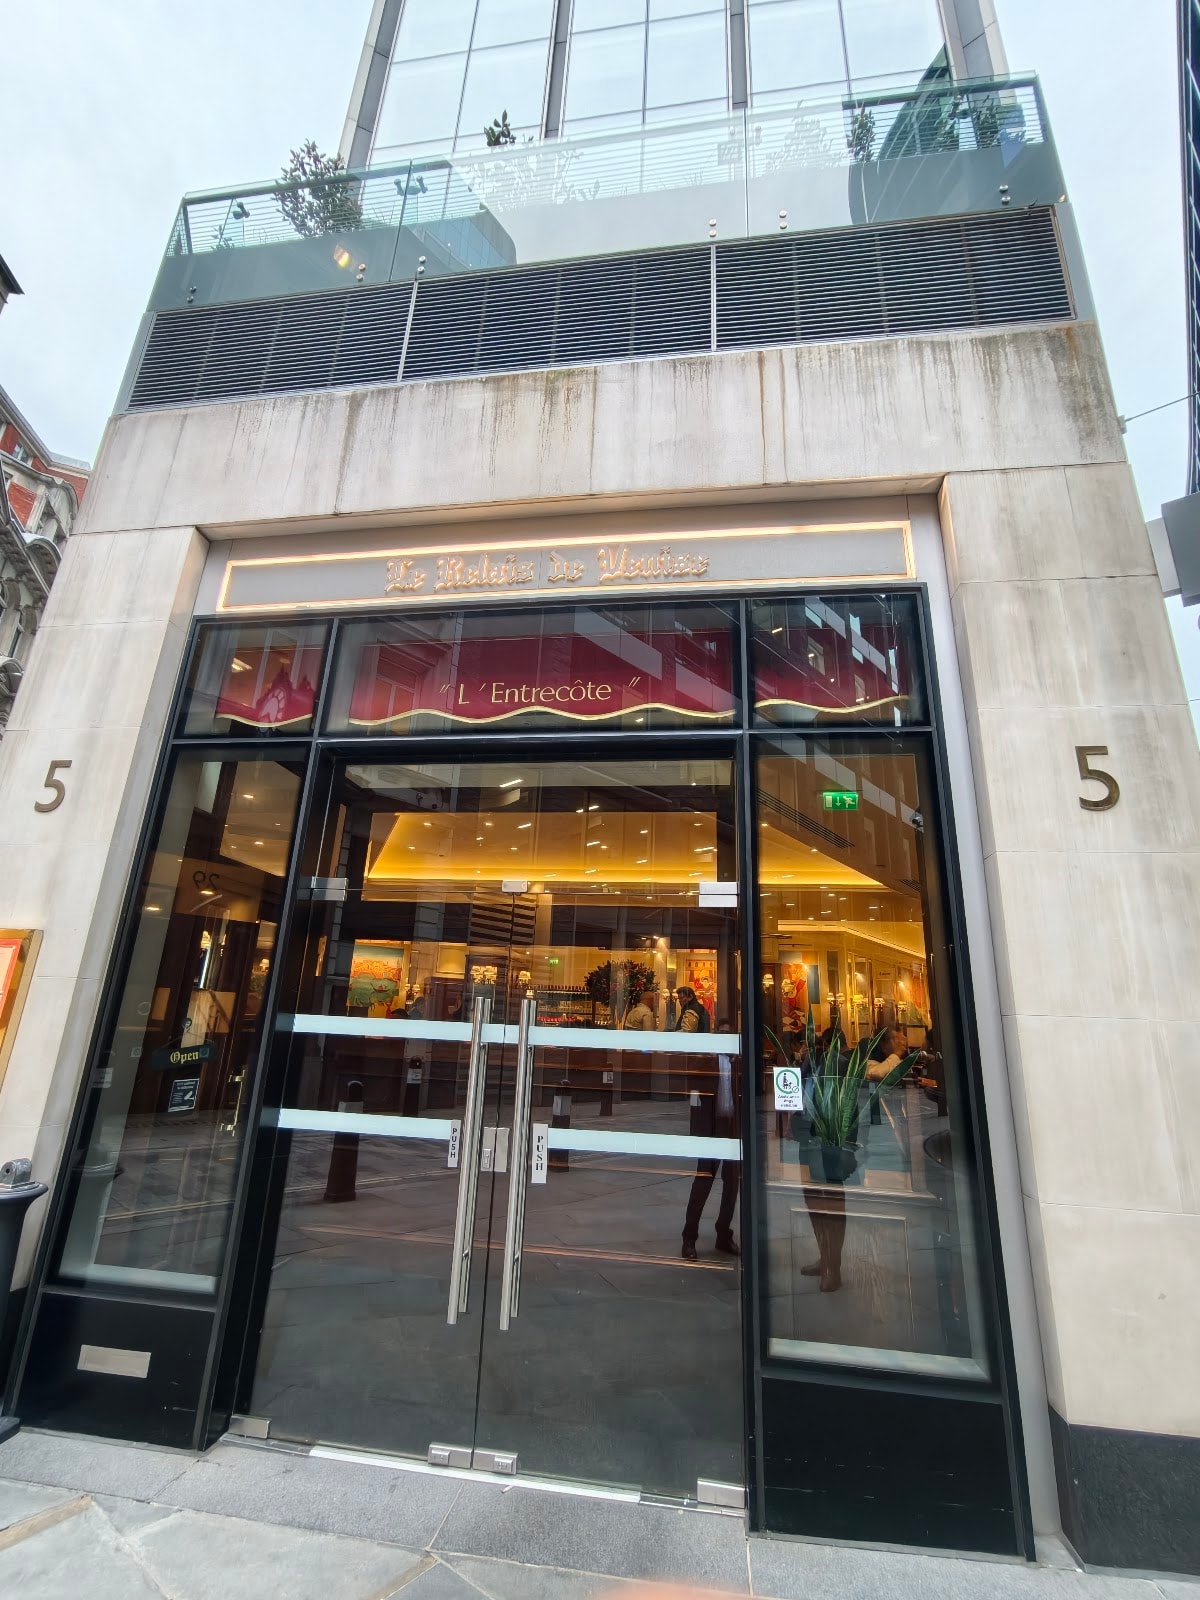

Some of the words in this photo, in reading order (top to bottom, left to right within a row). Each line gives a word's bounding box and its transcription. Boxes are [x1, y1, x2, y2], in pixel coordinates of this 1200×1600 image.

[385, 557, 426, 592] Le
[433, 550, 534, 592] Relais
[548, 550, 584, 582] de
[598, 543, 710, 583] Venise
[34, 759, 73, 813] 5
[1075, 745, 1120, 812] 5
[170, 1051, 199, 1065] Open
[450, 1127, 458, 1159] PUSH
[535, 1135, 544, 1171] PUSH
